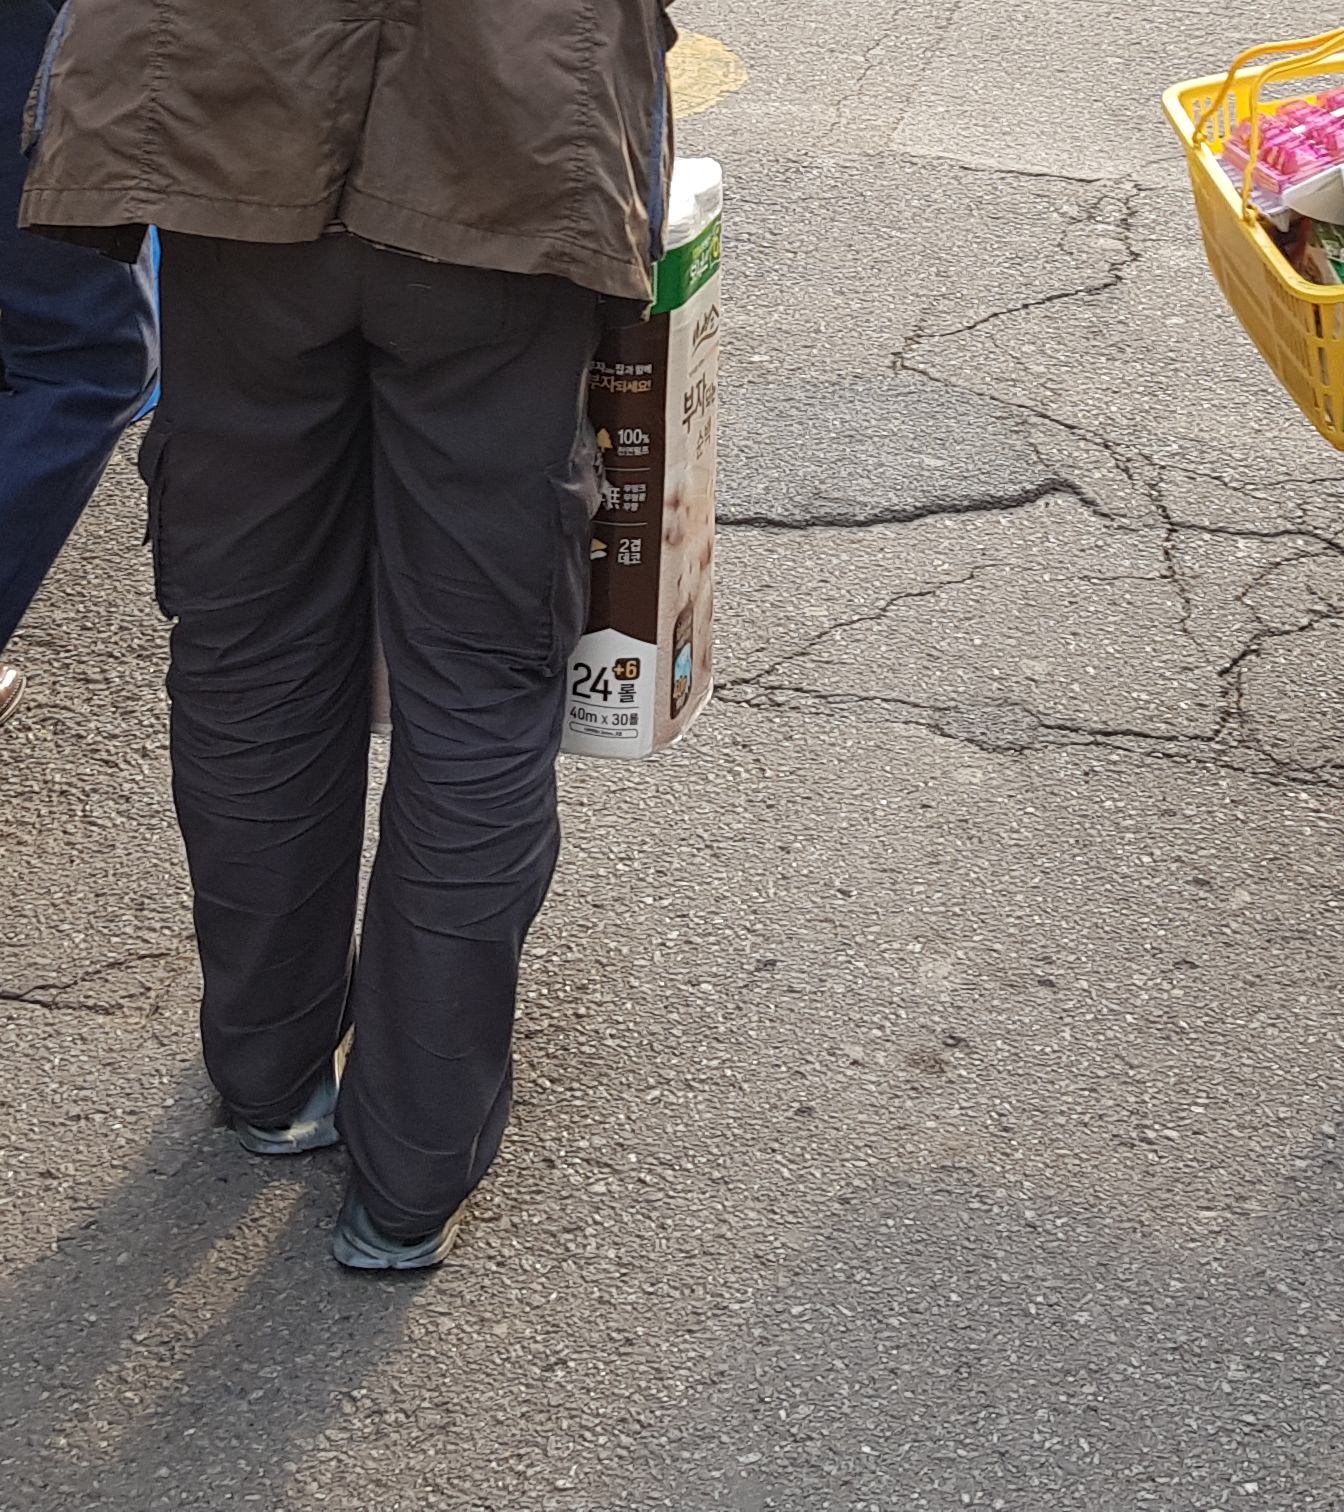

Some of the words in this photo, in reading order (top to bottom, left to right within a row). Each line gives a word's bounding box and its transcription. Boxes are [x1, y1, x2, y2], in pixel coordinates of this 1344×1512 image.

[617, 428, 650, 445] 100%
[572, 662, 613, 702] 24
[618, 683, 637, 703] 롤
[570, 706, 597, 723] 40m
